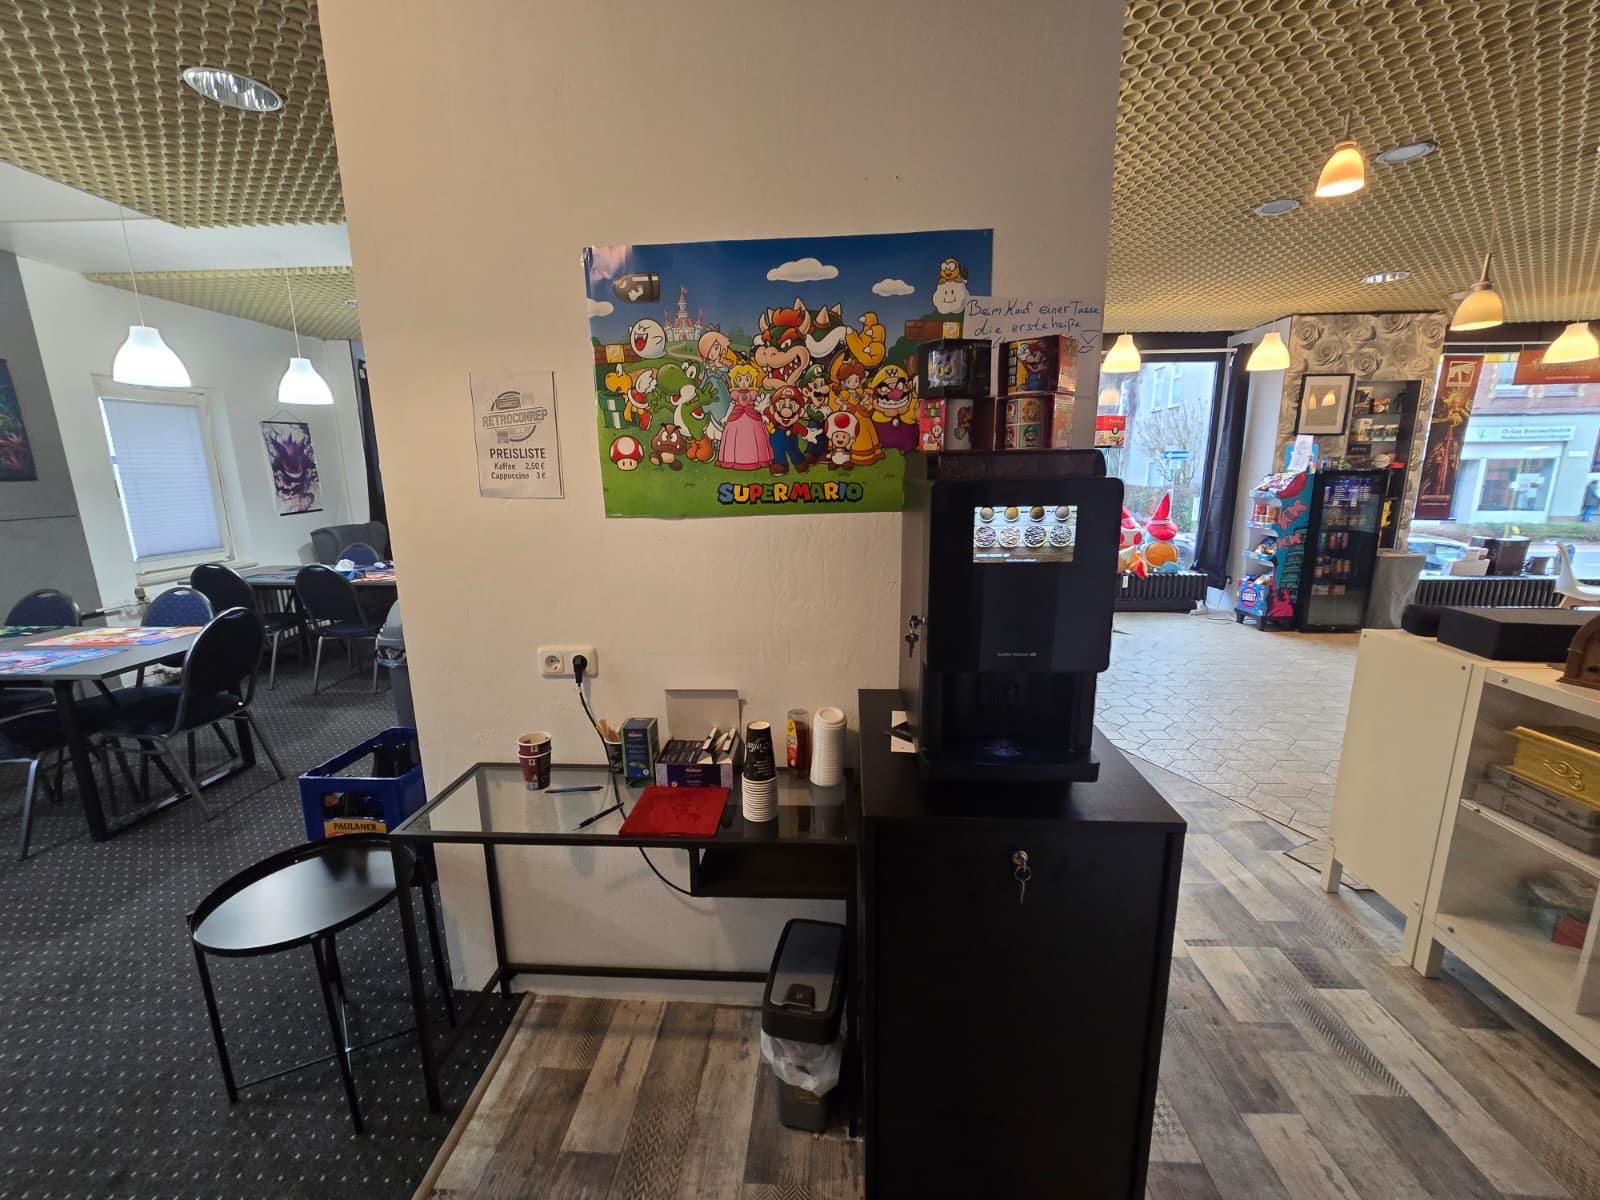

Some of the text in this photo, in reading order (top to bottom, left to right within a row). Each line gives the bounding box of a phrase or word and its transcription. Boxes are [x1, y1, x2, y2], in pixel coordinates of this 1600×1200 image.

[1004, 299, 1033, 316] Kauf
[1039, 304, 1070, 315] einer
[1071, 301, 1100, 315] Tasse
[974, 318, 1003, 336] die
[1012, 317, 1048, 332] erste
[489, 447, 547, 460] PREISLISTE
[494, 462, 516, 471] Kaffee
[491, 471, 530, 481] Cappuccino
[718, 481, 864, 505] SUPER MARIO
[333, 822, 377, 832] PAULANER
